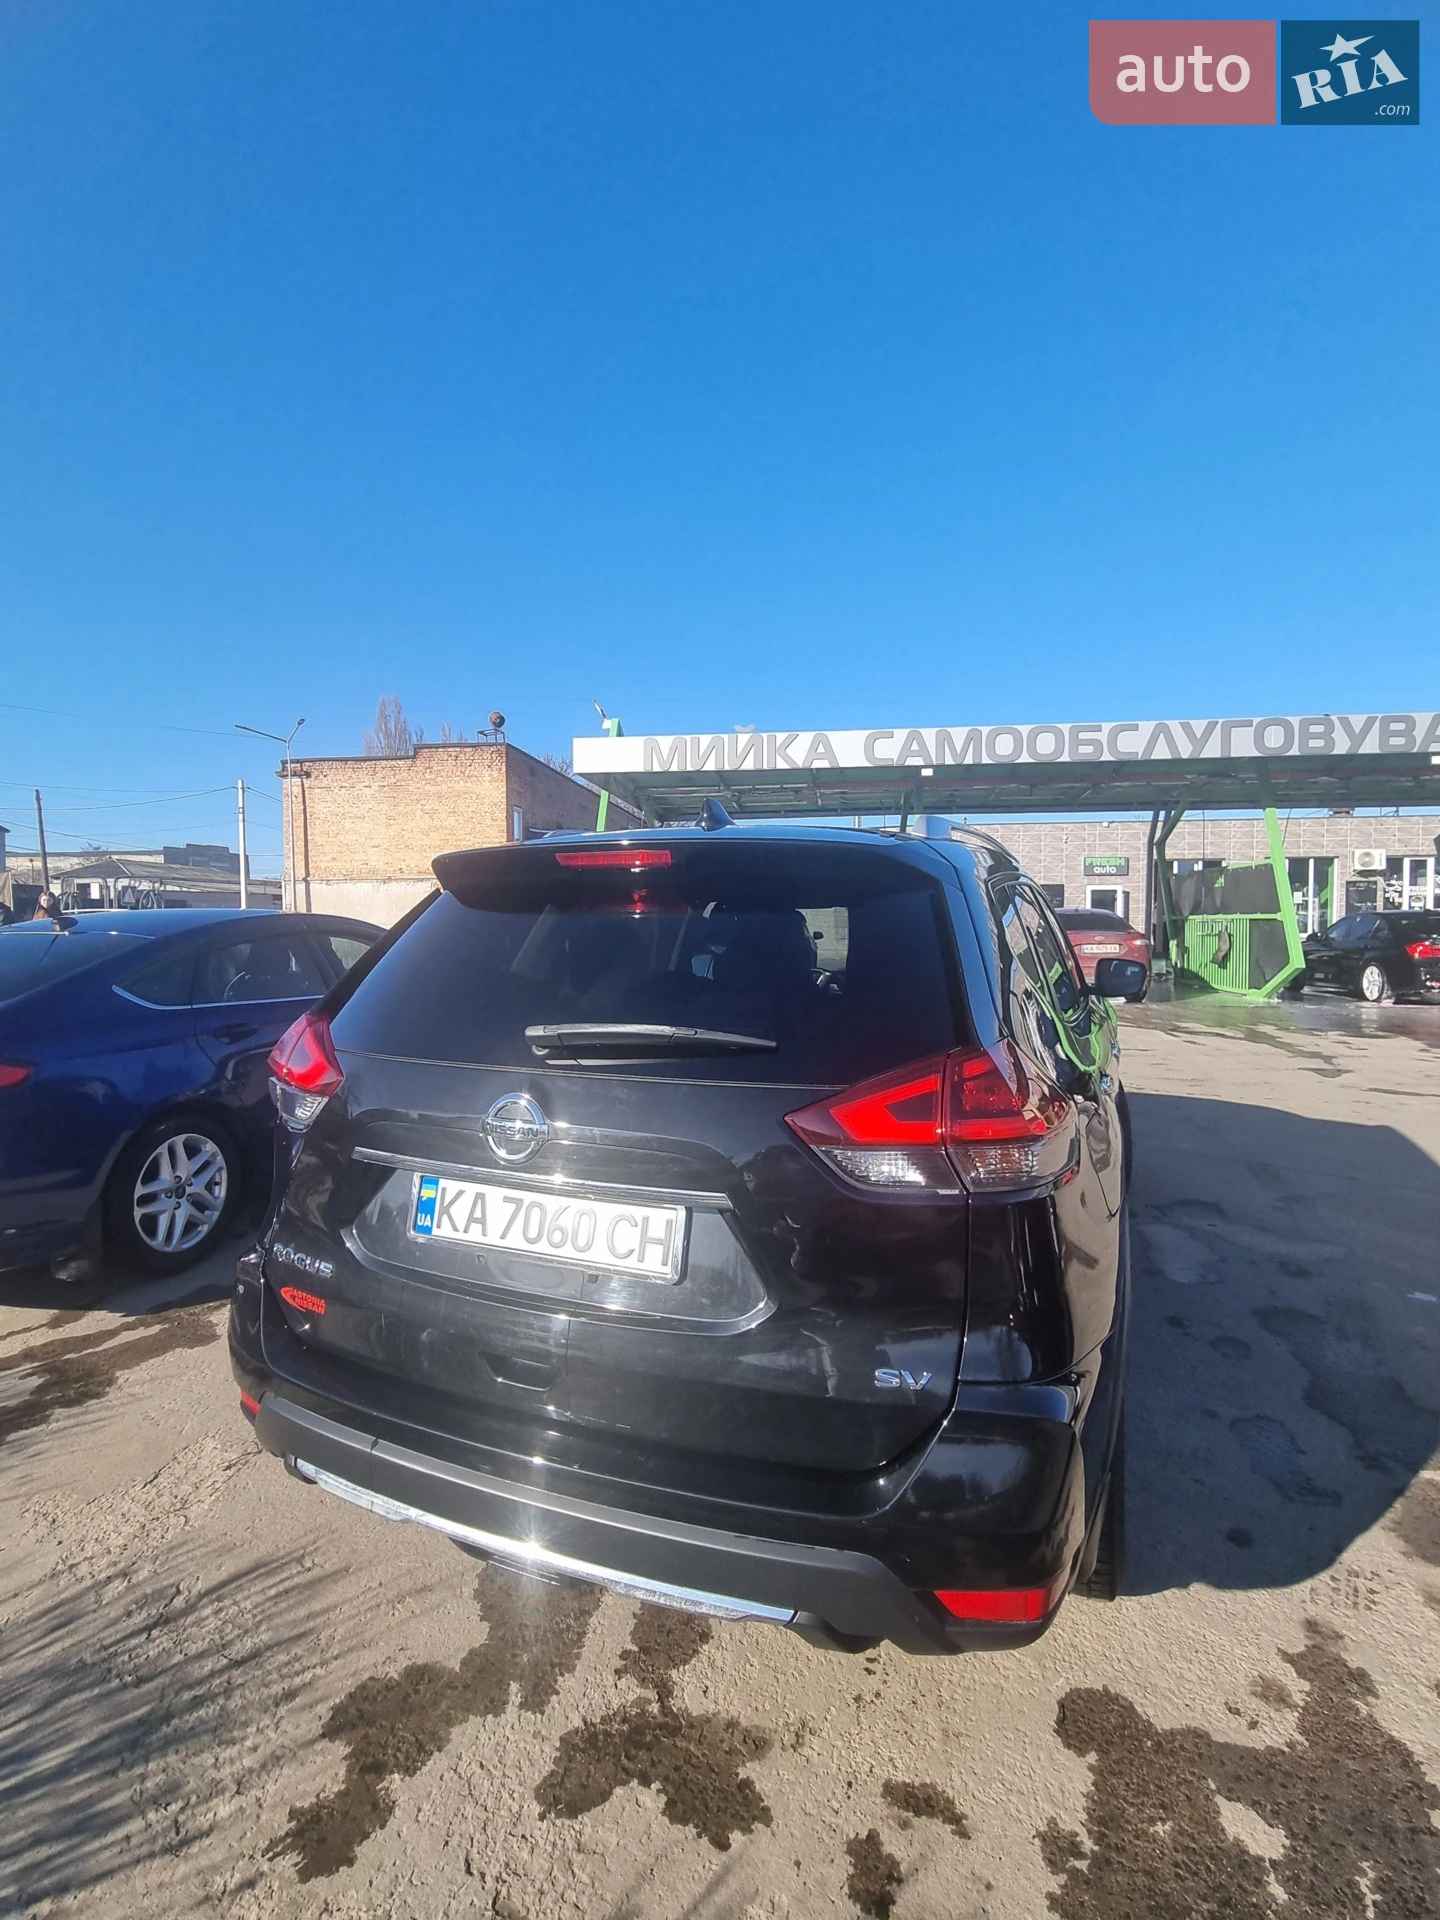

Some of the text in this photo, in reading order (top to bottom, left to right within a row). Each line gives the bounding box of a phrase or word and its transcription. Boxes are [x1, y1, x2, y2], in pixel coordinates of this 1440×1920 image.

[643, 723, 840, 772] МИЙКА
[1085, 857, 1125, 866] FRESH
[481, 1120, 539, 1138] NISSAN
[417, 1213, 432, 1228] UA
[436, 1187, 673, 1267] KA 7060 CH
[273, 1243, 334, 1278] ROGUE
[874, 1368, 933, 1390] SV
